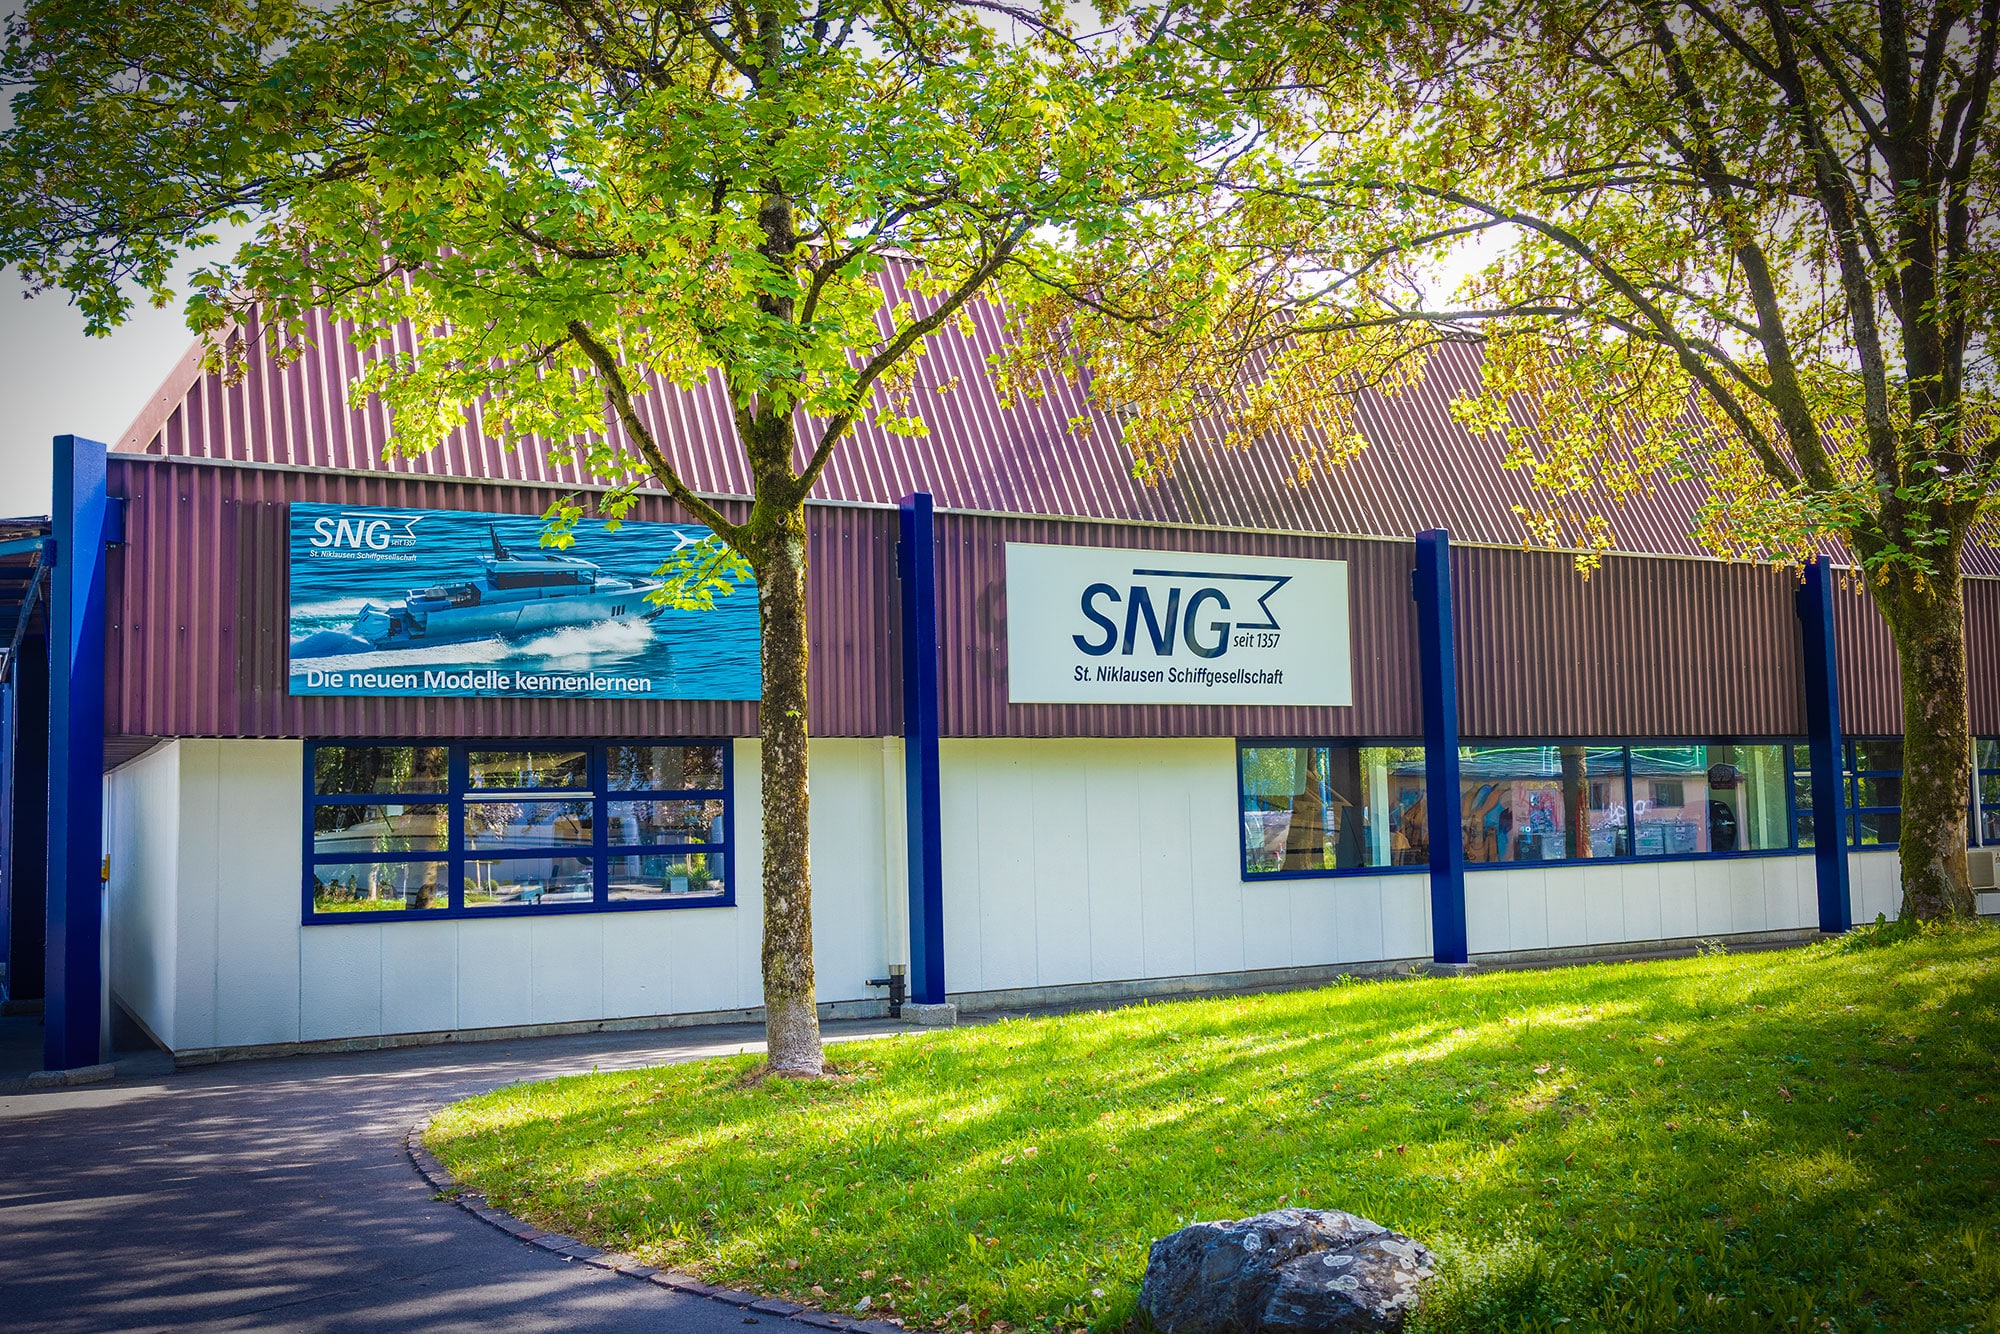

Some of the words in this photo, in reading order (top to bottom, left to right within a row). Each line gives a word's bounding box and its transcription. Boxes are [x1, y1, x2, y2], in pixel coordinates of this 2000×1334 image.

[309, 517, 391, 550] SNG
[320, 551, 355, 559] Niklausen
[356, 552, 417, 561] Schiffgesellschaft
[1072, 583, 1231, 658] SNG
[1233, 633, 1254, 647] seit
[1257, 633, 1280, 648] 1357
[307, 670, 343, 688] Die
[349, 672, 418, 689] neuen
[424, 671, 510, 690] Modelle
[515, 672, 651, 692] kennenlernen
[1074, 665, 1092, 682] St.
[1097, 666, 1164, 683] Niklausen
[1168, 668, 1284, 687] Schiffgesellschaft
